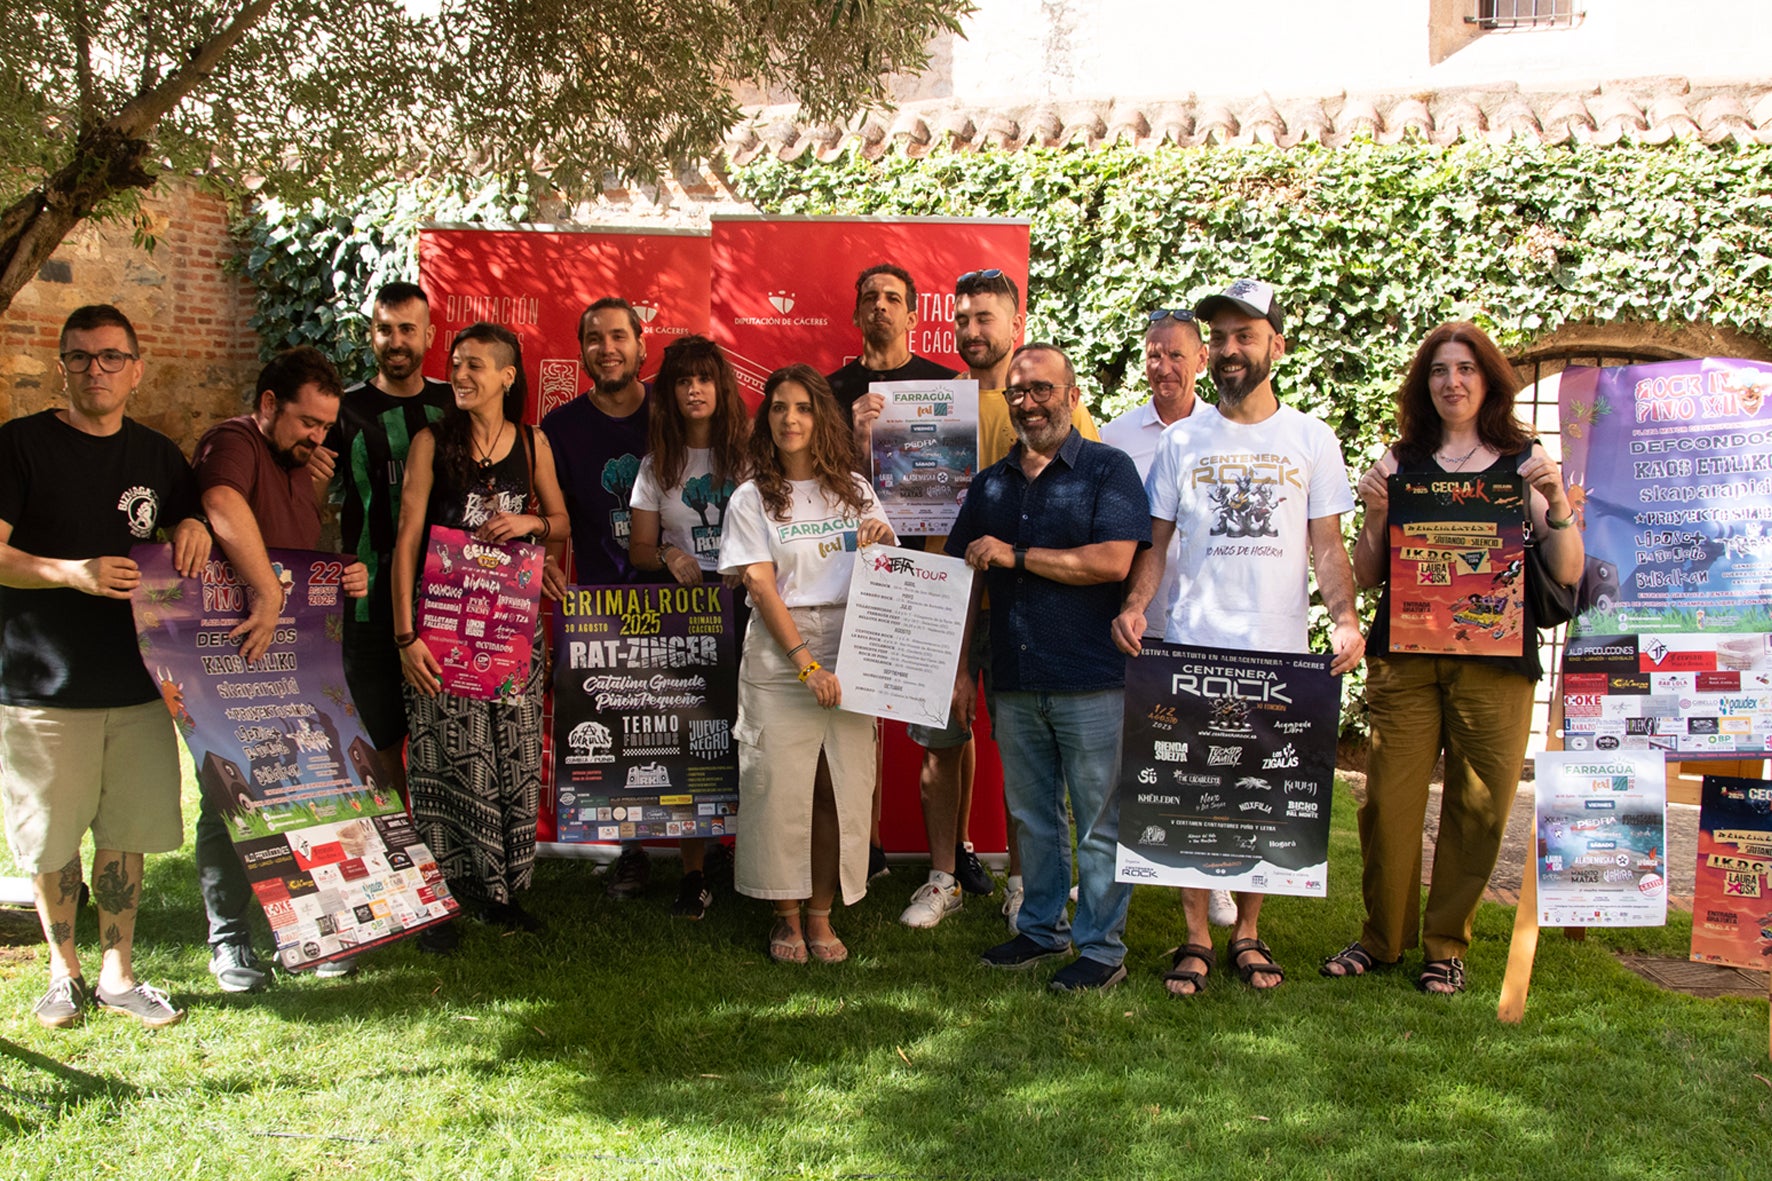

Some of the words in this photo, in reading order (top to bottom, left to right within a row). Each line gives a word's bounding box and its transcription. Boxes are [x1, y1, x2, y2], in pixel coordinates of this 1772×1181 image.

[446, 293, 540, 325] DIPUTACIÓN
[734, 316, 781, 326] DIPUTACIÓN
[782, 317, 791, 326] DE
[793, 317, 829, 326] CÁCERES
[656, 326, 689, 335] CÁCERES
[1635, 374, 1704, 400] ROCK
[1635, 396, 1695, 423] PINO
[1199, 453, 1292, 466] CENTENERA
[1191, 463, 1302, 489] ROCK
[1634, 458, 1693, 480] KAOS
[1431, 481, 1471, 493] CECLA
[1236, 545, 1249, 556] DE
[308, 561, 342, 586] 22
[915, 567, 948, 582] TOUR
[1421, 563, 1447, 573] LAURA
[202, 586, 244, 613] PINO
[308, 595, 337, 606] 2025
[565, 623, 575, 633] 30
[578, 622, 609, 633] AGOSTO
[619, 613, 661, 635] 2025
[688, 615, 723, 624] GRIMALDO
[688, 624, 724, 634] (CÁCERES)
[569, 635, 719, 669] RAT-ZINGER
[1141, 648, 1170, 657] ESTIVAL
[1172, 650, 1207, 660] GRATUITO
[1220, 654, 1283, 666] ALDEACENTENERA
[1292, 660, 1325, 670] CÁCERES
[201, 655, 244, 675] KAOS
[1182, 664, 1278, 681] CENTENERA
[583, 674, 649, 693] Catalina
[650, 674, 706, 690] Grande
[1171, 673, 1293, 704] ROCK
[595, 691, 642, 711] Piñón
[640, 690, 707, 709] Pequeño
[622, 714, 679, 733] TERMO
[689, 719, 729, 739] JUEVES
[1151, 722, 1173, 731] 2025
[689, 730, 729, 751] NEGRO
[1262, 756, 1299, 770] ZIGALAS
[1287, 800, 1318, 812] BICHO
[1121, 868, 1159, 878] ROCK
[1571, 876, 1600, 884] MATAS
[1728, 872, 1758, 885] LAURA
